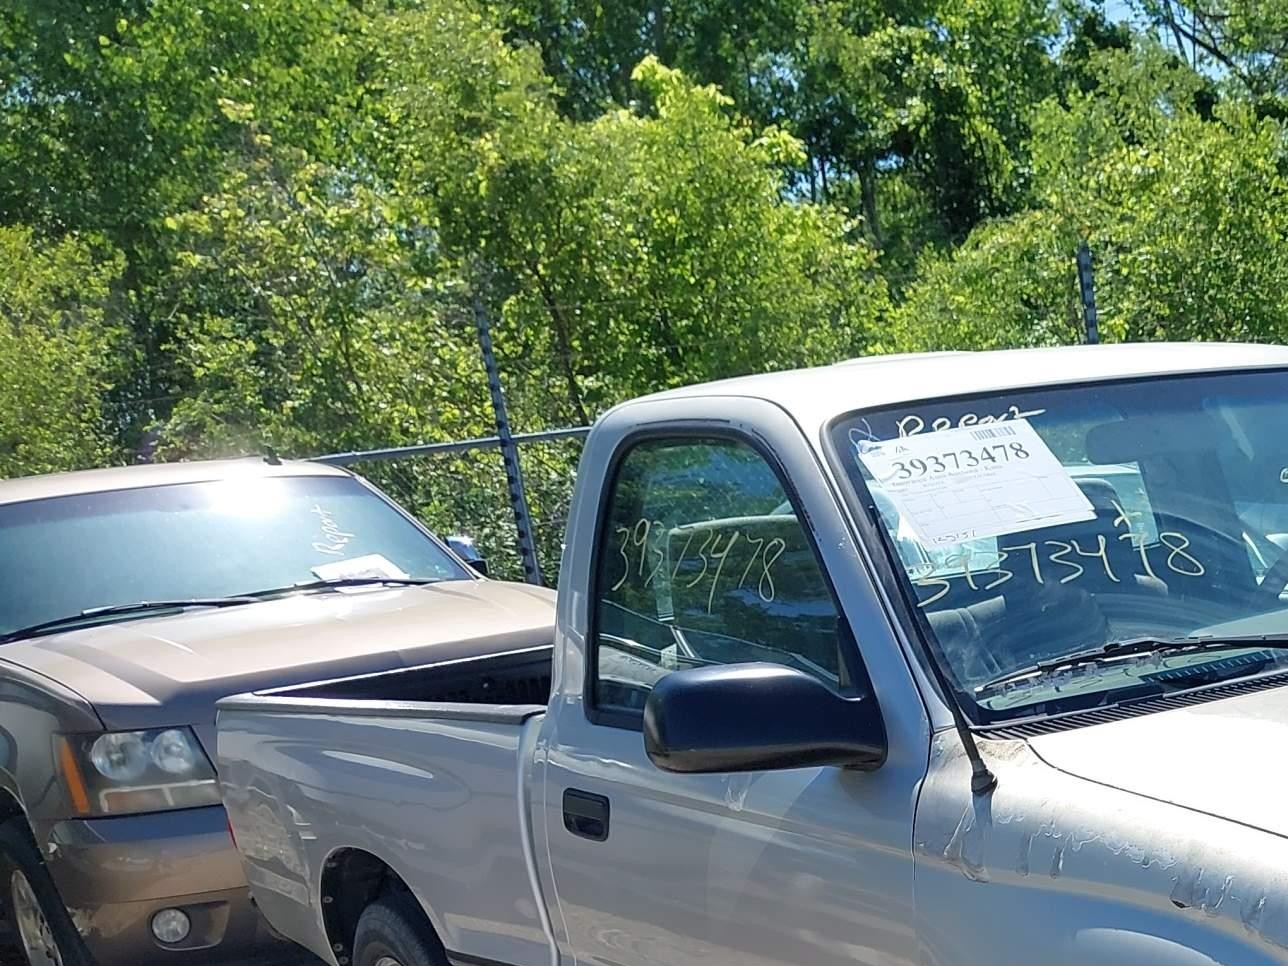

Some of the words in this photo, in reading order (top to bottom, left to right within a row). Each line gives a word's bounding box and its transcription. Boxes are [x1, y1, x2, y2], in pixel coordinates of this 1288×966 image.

[891, 441, 1031, 479] 39373478
[310, 504, 355, 556] Report
[611, 518, 786, 616] 39373478
